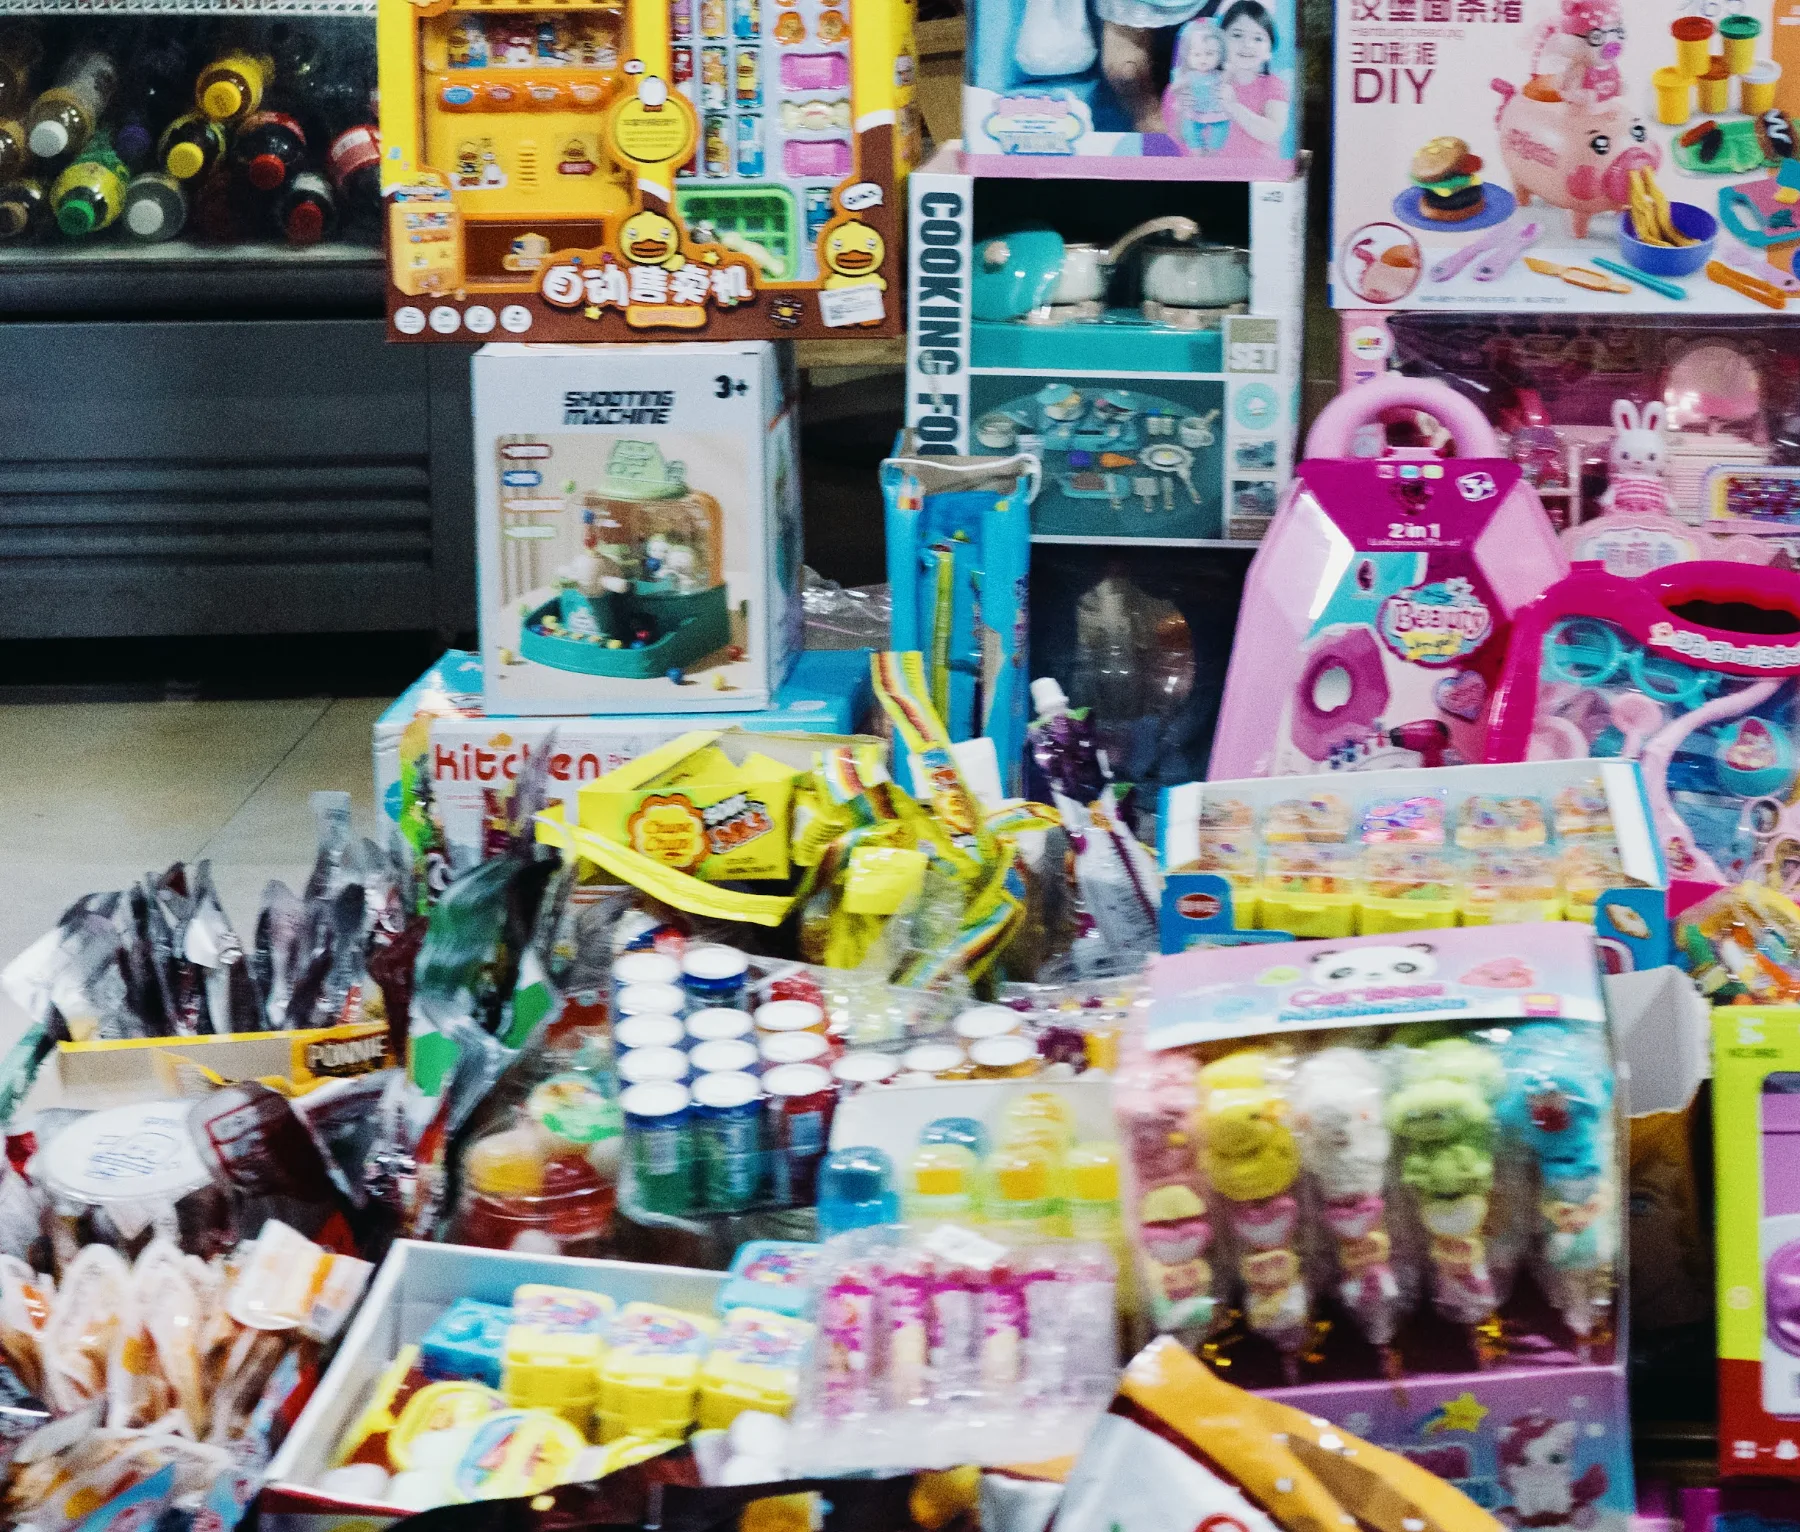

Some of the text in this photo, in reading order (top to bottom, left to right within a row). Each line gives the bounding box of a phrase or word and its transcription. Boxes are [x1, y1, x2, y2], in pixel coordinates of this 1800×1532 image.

[1353, 67, 1436, 105] DIY
[543, 264, 754, 307] 自动售卖机
[917, 191, 963, 376] COOKING
[563, 391, 676, 408] SHOOTING
[713, 375, 749, 399] 3+
[562, 408, 671, 425] MACHINE
